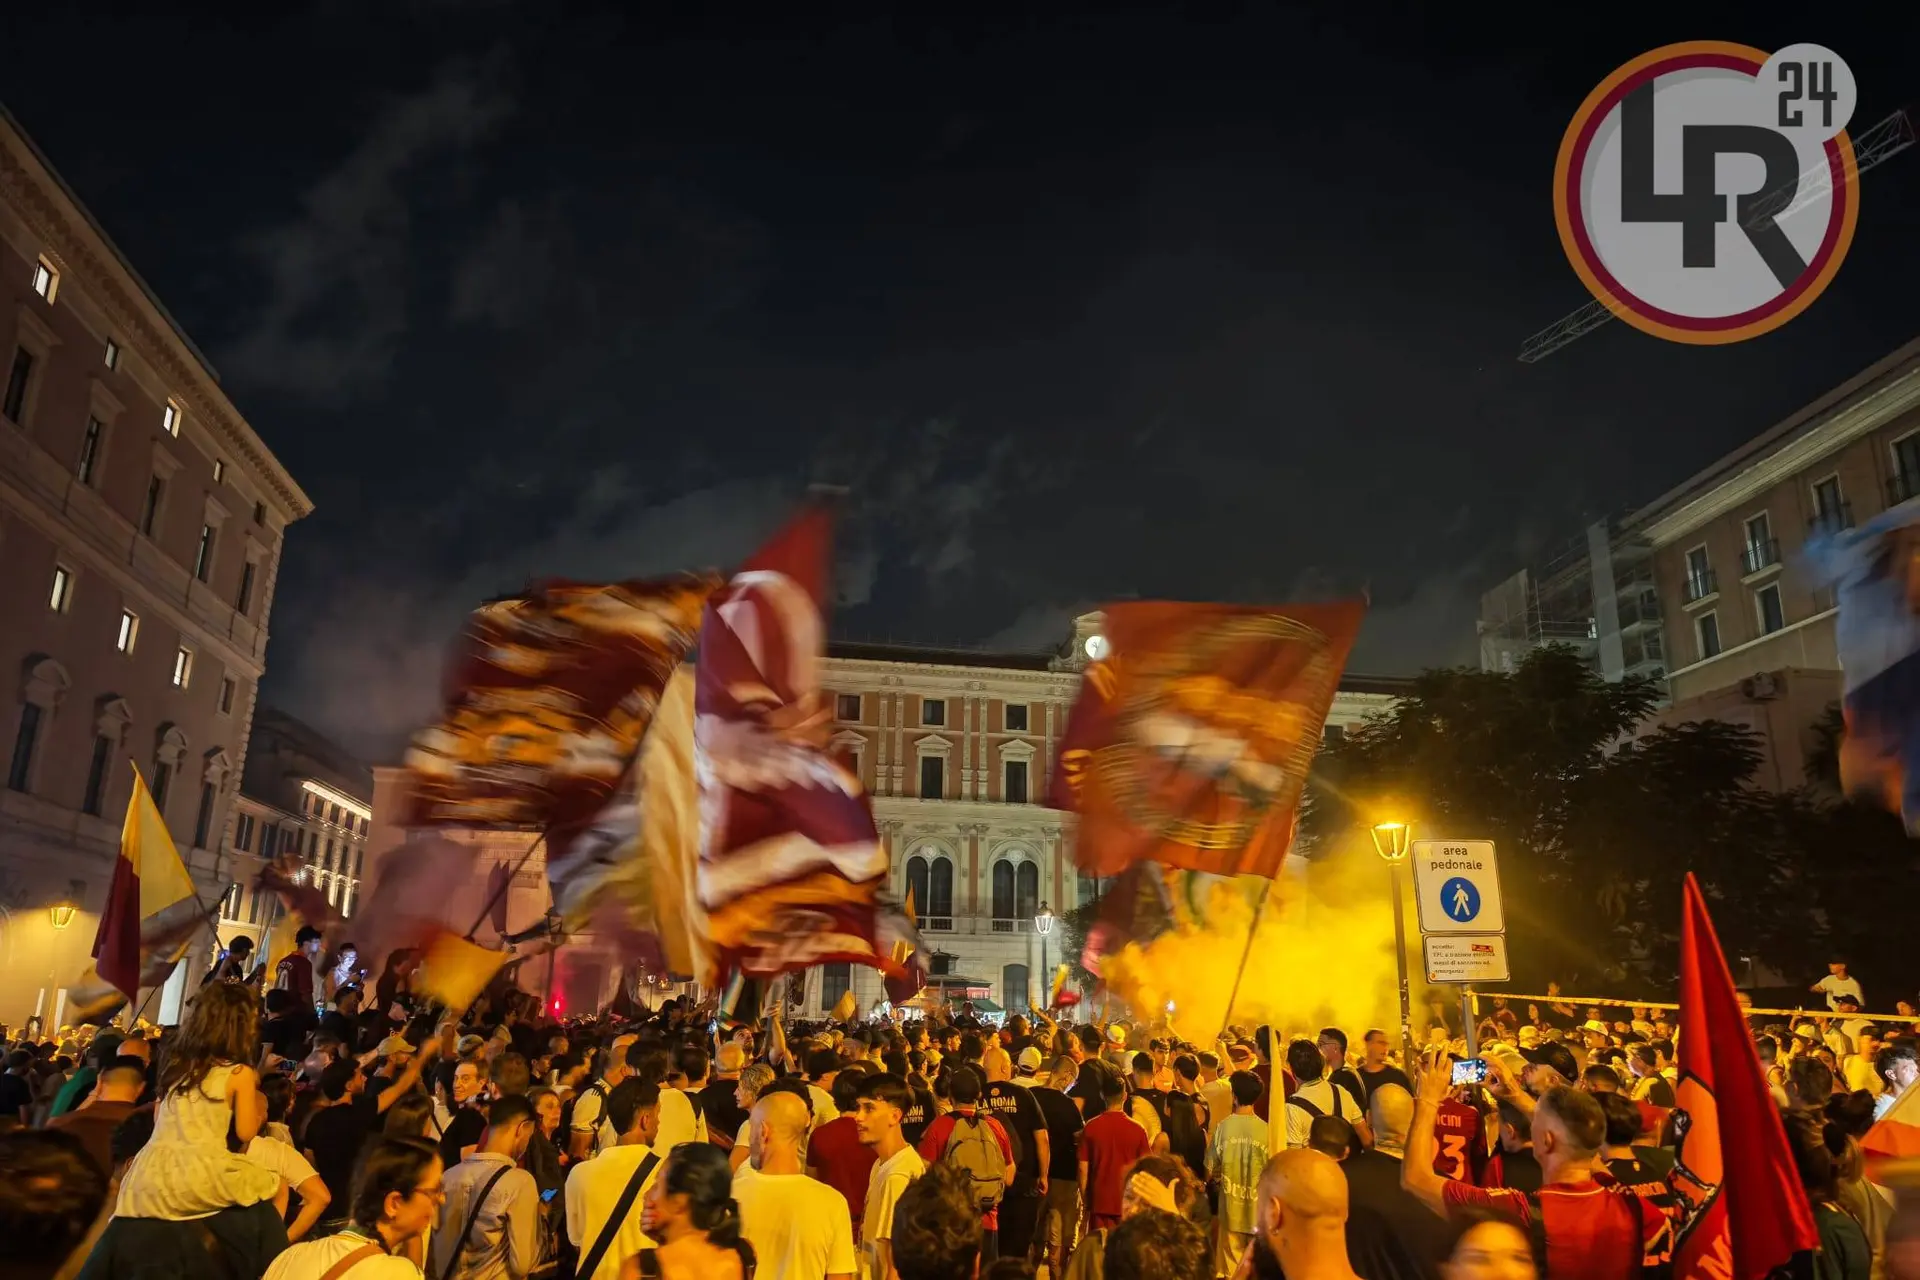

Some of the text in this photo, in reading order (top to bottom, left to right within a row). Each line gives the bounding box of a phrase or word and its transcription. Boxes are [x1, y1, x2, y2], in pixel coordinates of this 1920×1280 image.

[1443, 846, 1468, 856] area
[1430, 859, 1483, 871] pedonale
[990, 1096, 1016, 1107] ROMA
